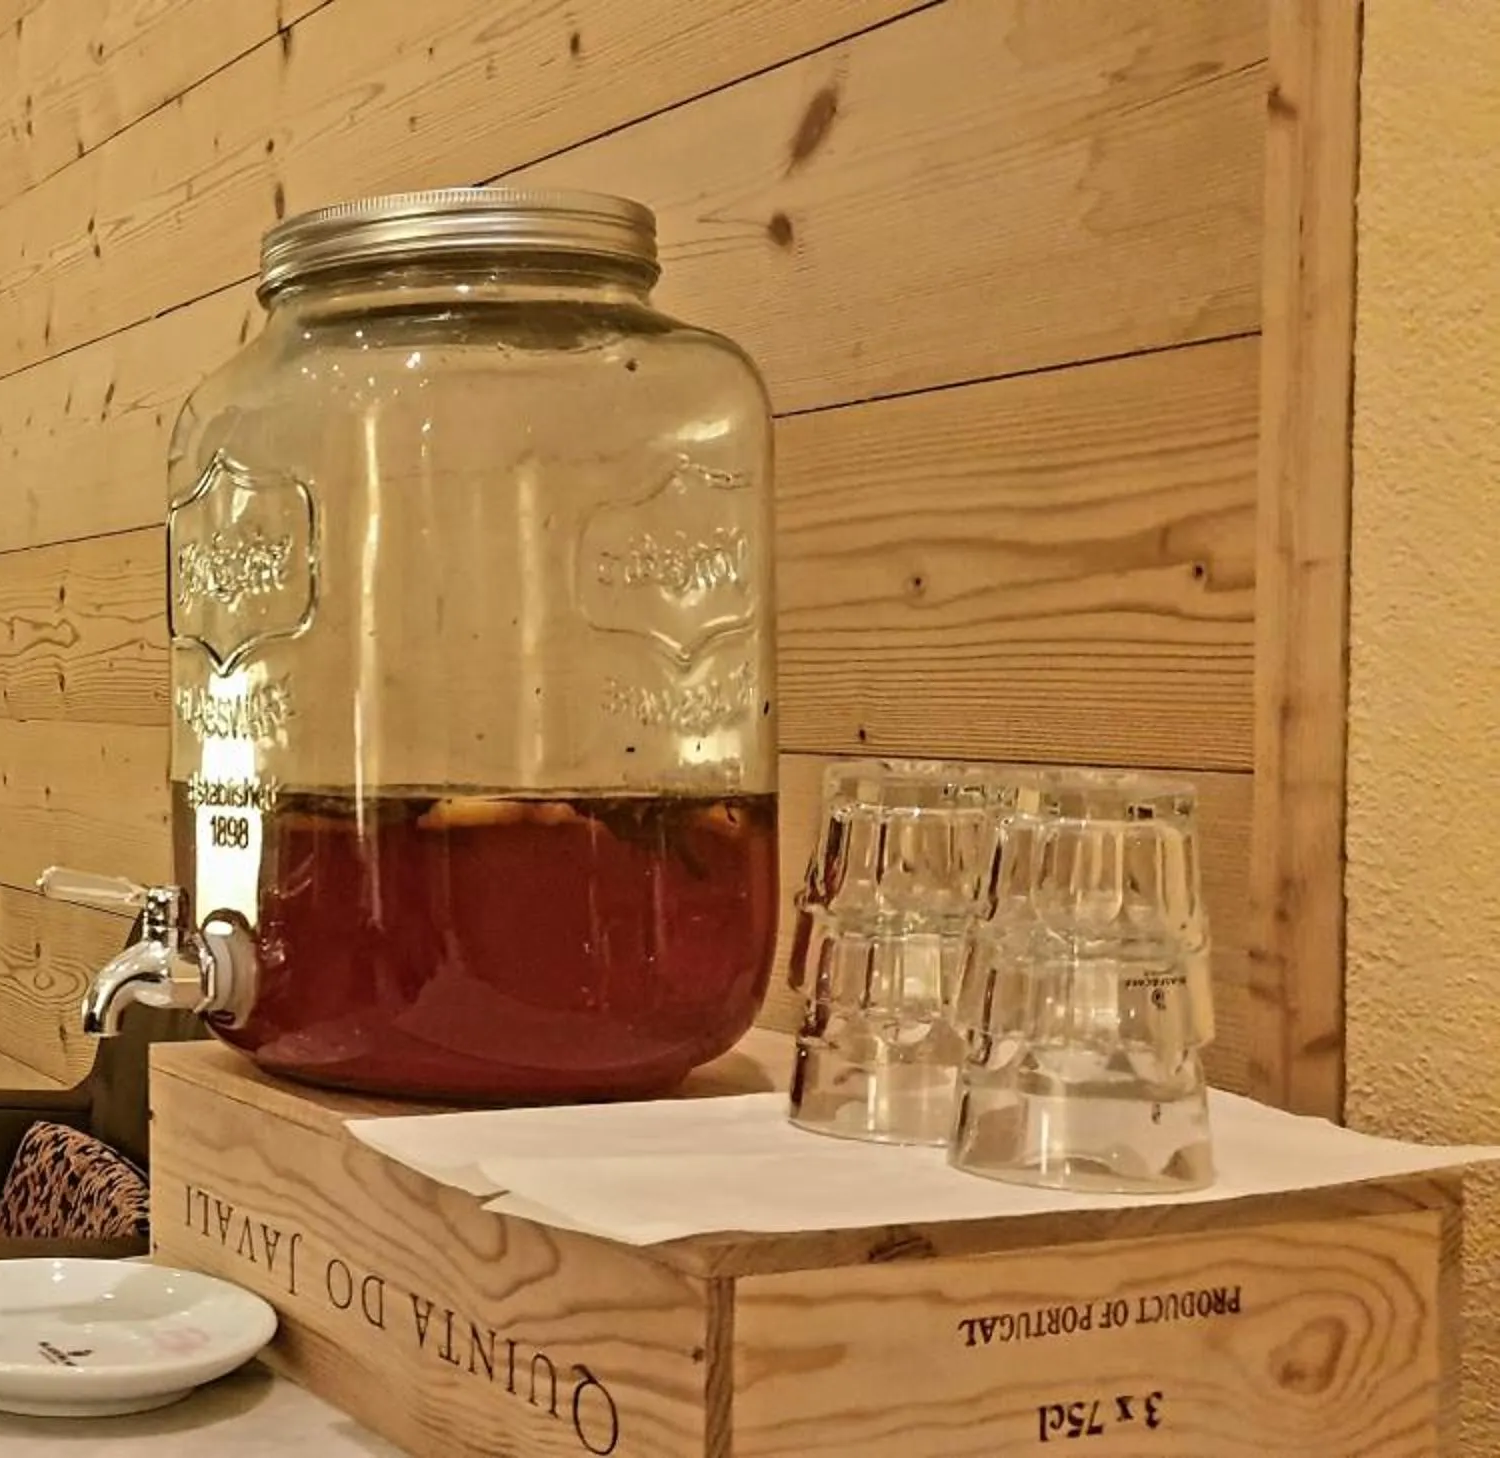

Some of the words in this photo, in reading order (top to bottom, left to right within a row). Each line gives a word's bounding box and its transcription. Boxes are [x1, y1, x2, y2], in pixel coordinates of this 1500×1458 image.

[210, 814, 249, 850] 1898
[184, 1184, 303, 1296] JAVALI
[325, 1258, 387, 1331] DO
[1099, 1299, 1129, 1330] OF
[1135, 1286, 1242, 1325] PRODUCT
[958, 1303, 1093, 1347] PORTUGAL
[408, 1292, 619, 1456] QUINTA
[1037, 1400, 1104, 1442] 75cl
[1115, 1395, 1135, 1423] x
[1144, 1391, 1164, 1430] 3
